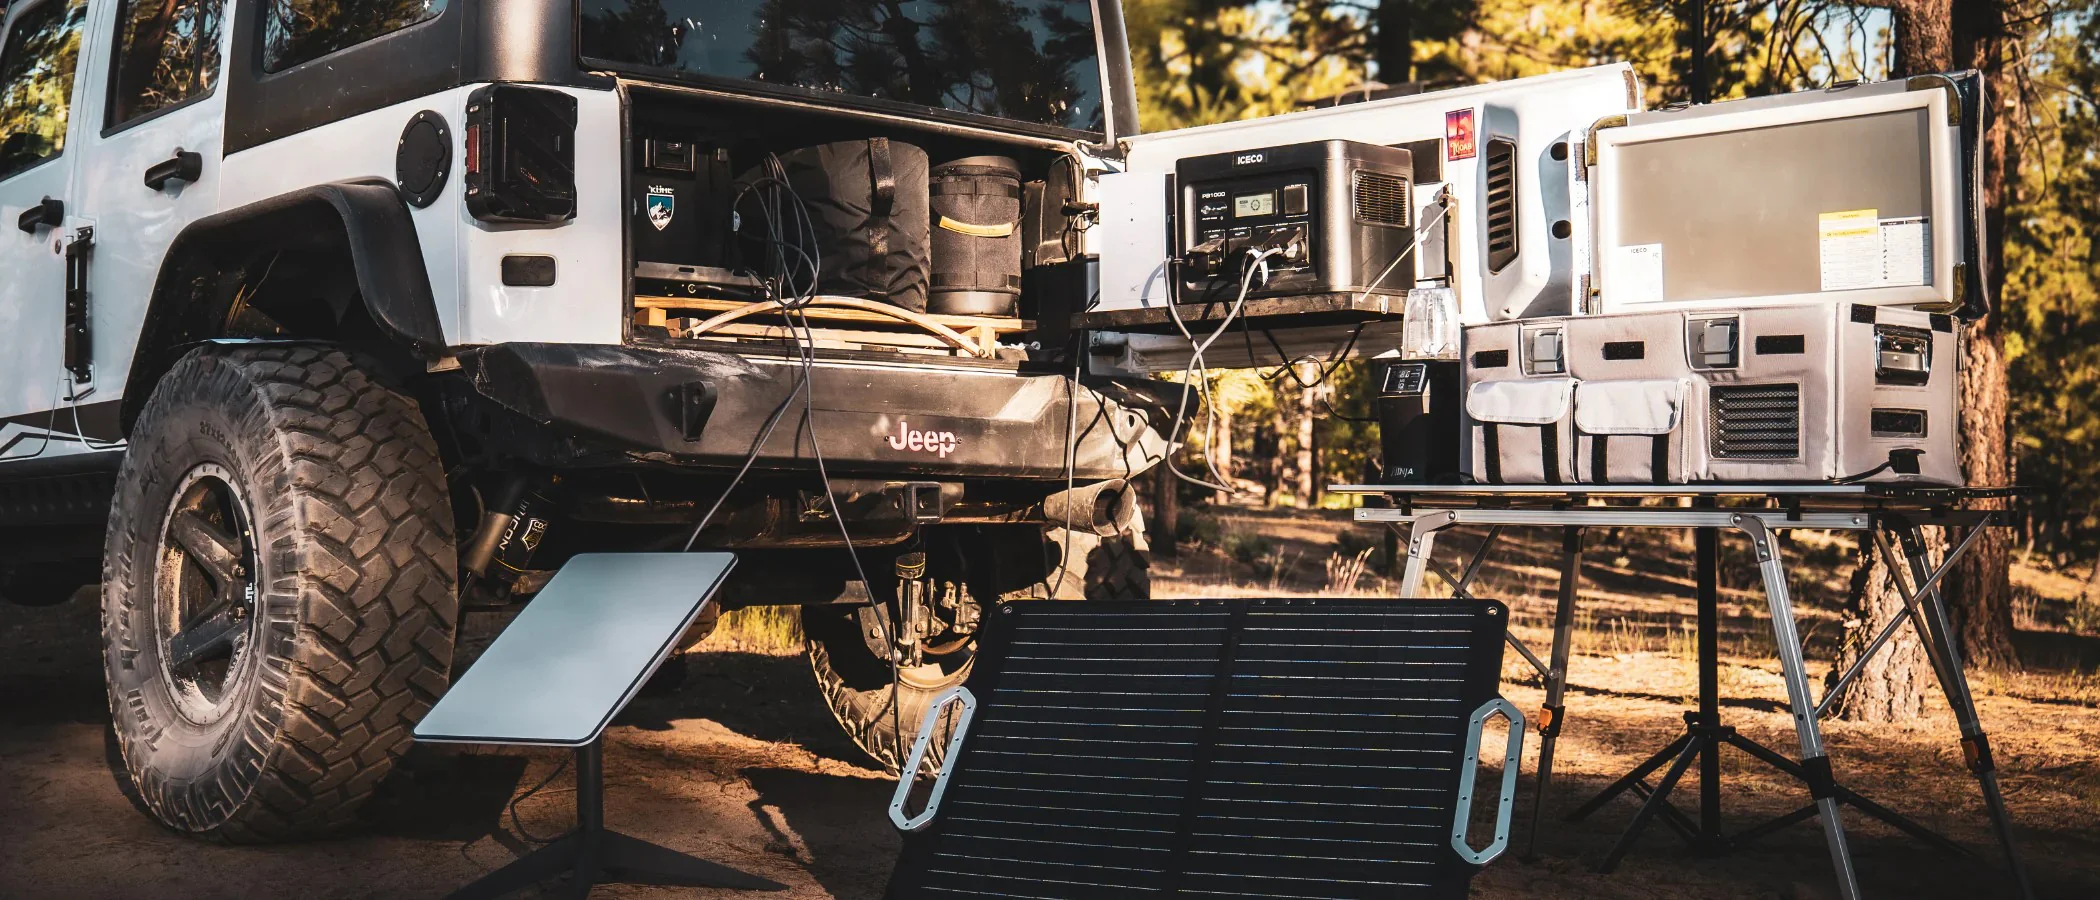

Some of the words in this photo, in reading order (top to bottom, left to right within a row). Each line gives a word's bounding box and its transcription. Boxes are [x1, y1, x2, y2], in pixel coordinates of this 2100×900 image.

[1237, 154, 1263, 165] ICECO
[1450, 142, 1472, 155] MOAB
[889, 421, 956, 459] Jeep
[499, 515, 521, 550] ICON
